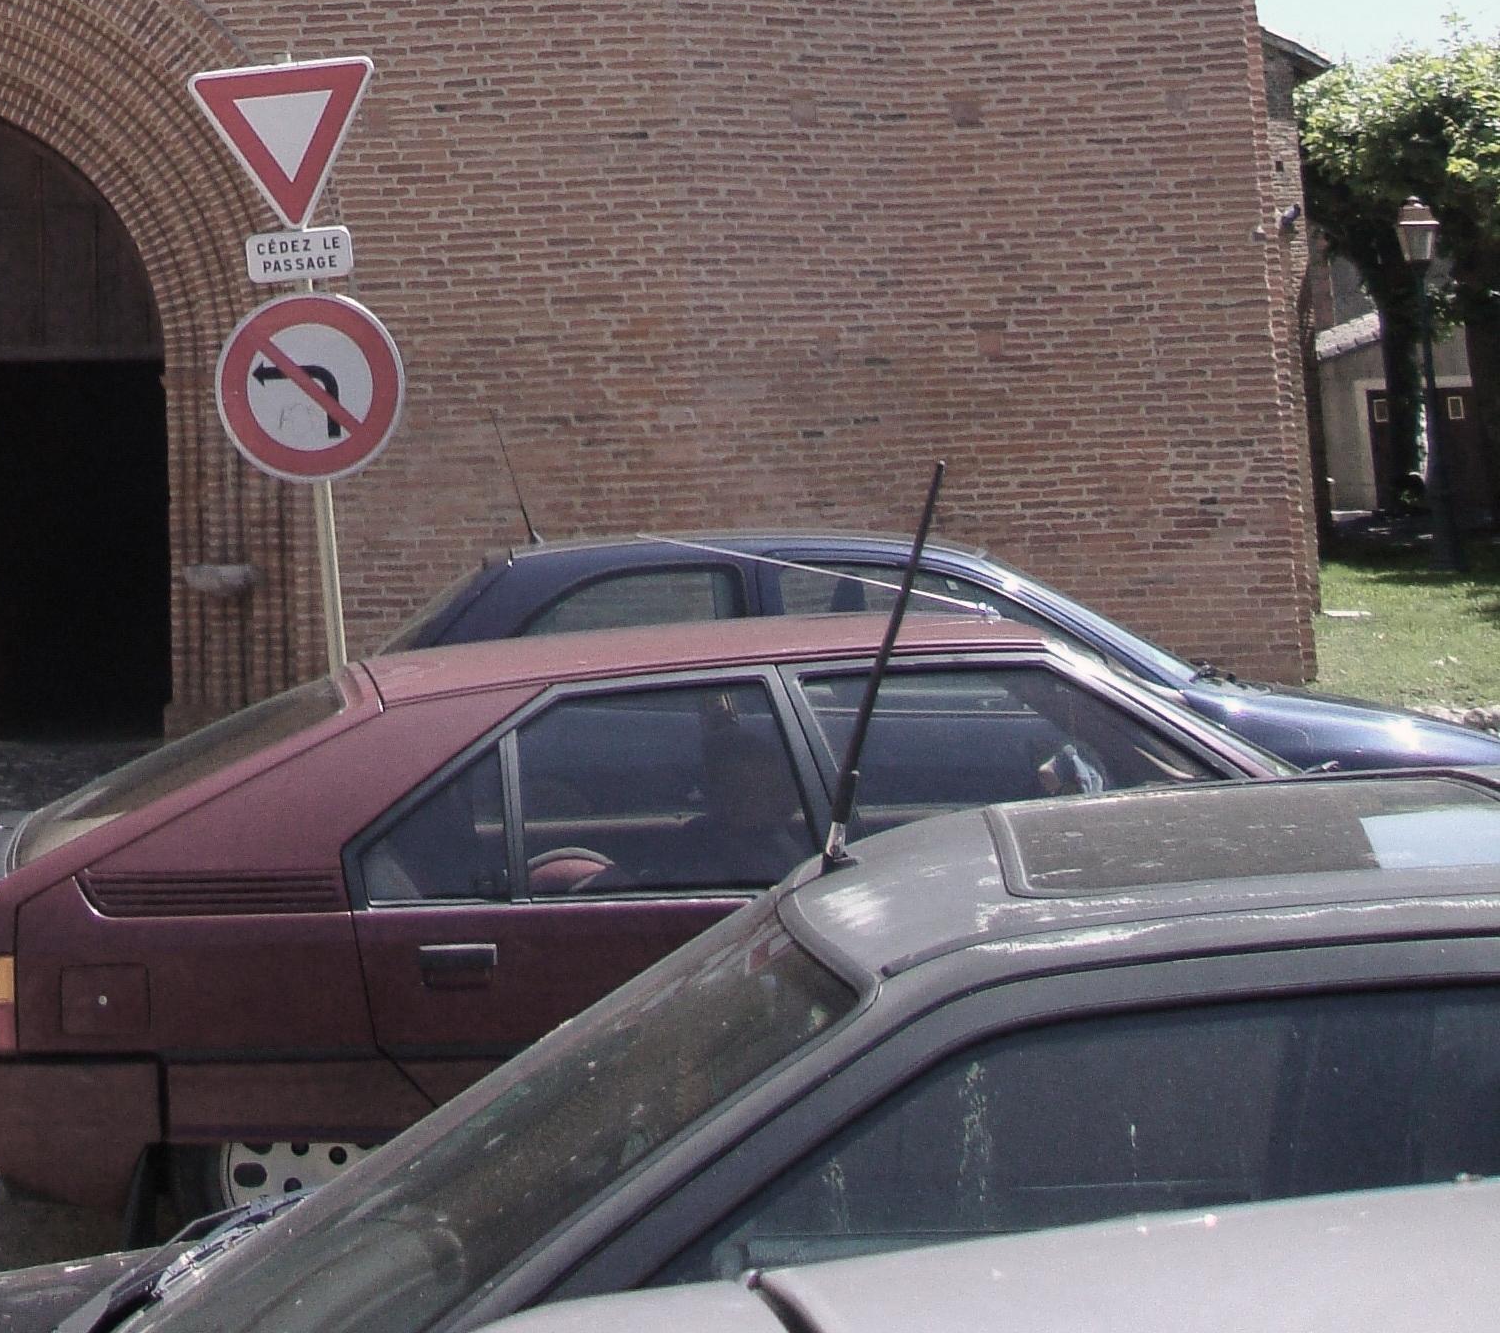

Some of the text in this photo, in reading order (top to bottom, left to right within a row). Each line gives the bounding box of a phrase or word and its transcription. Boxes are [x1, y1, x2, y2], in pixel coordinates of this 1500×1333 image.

[257, 236, 340, 255] CÉDEZ LE
[263, 255, 337, 273] PASSAGE
